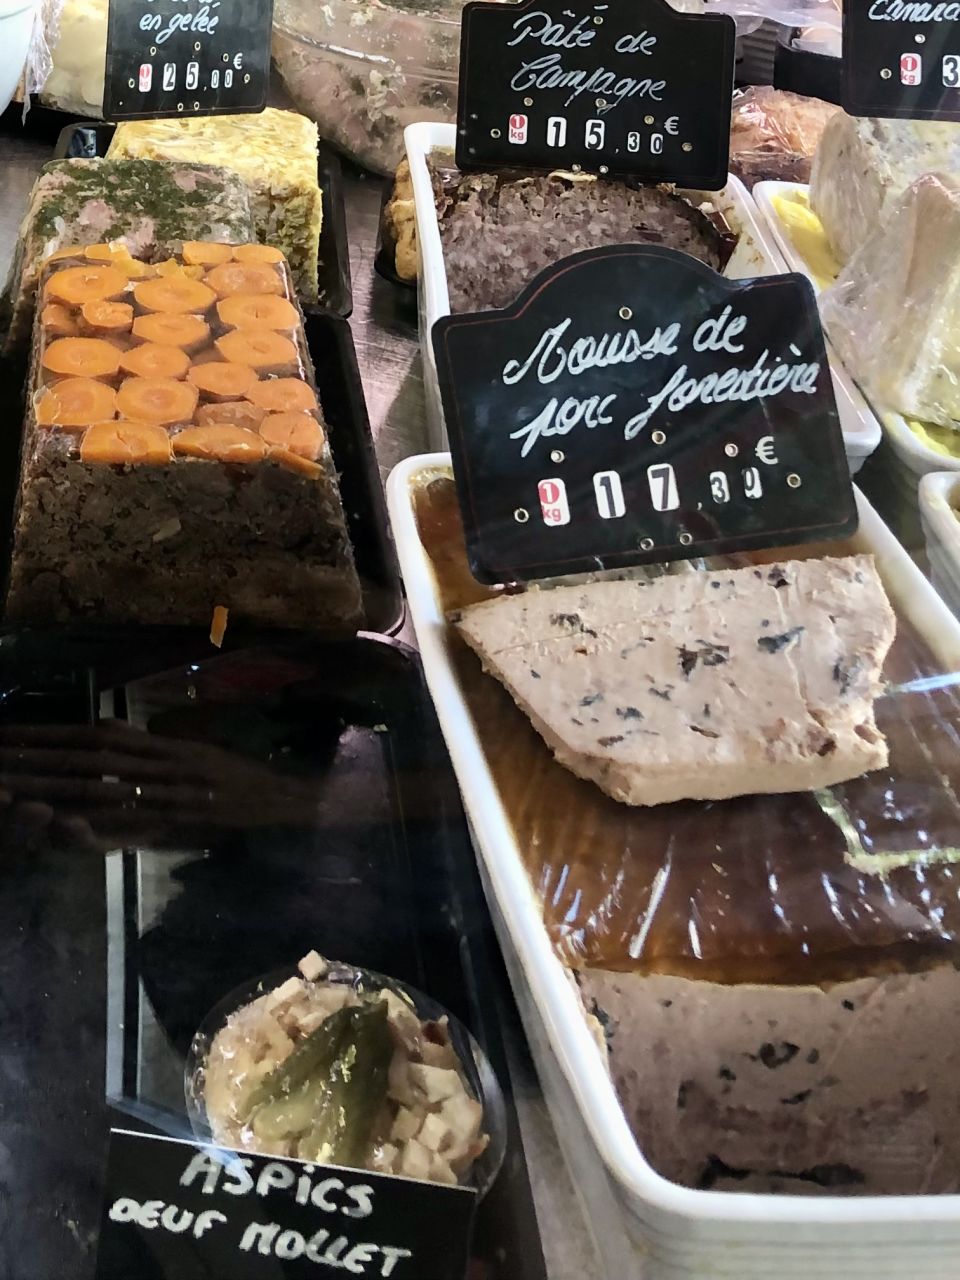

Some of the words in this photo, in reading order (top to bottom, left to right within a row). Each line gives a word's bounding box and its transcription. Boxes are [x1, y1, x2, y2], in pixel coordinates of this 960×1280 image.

[138, 12, 162, 32] en
[506, 4, 610, 50] Pâté
[613, 30, 658, 57] de
[509, 53, 668, 115] Campagne
[691, 303, 749, 354] de
